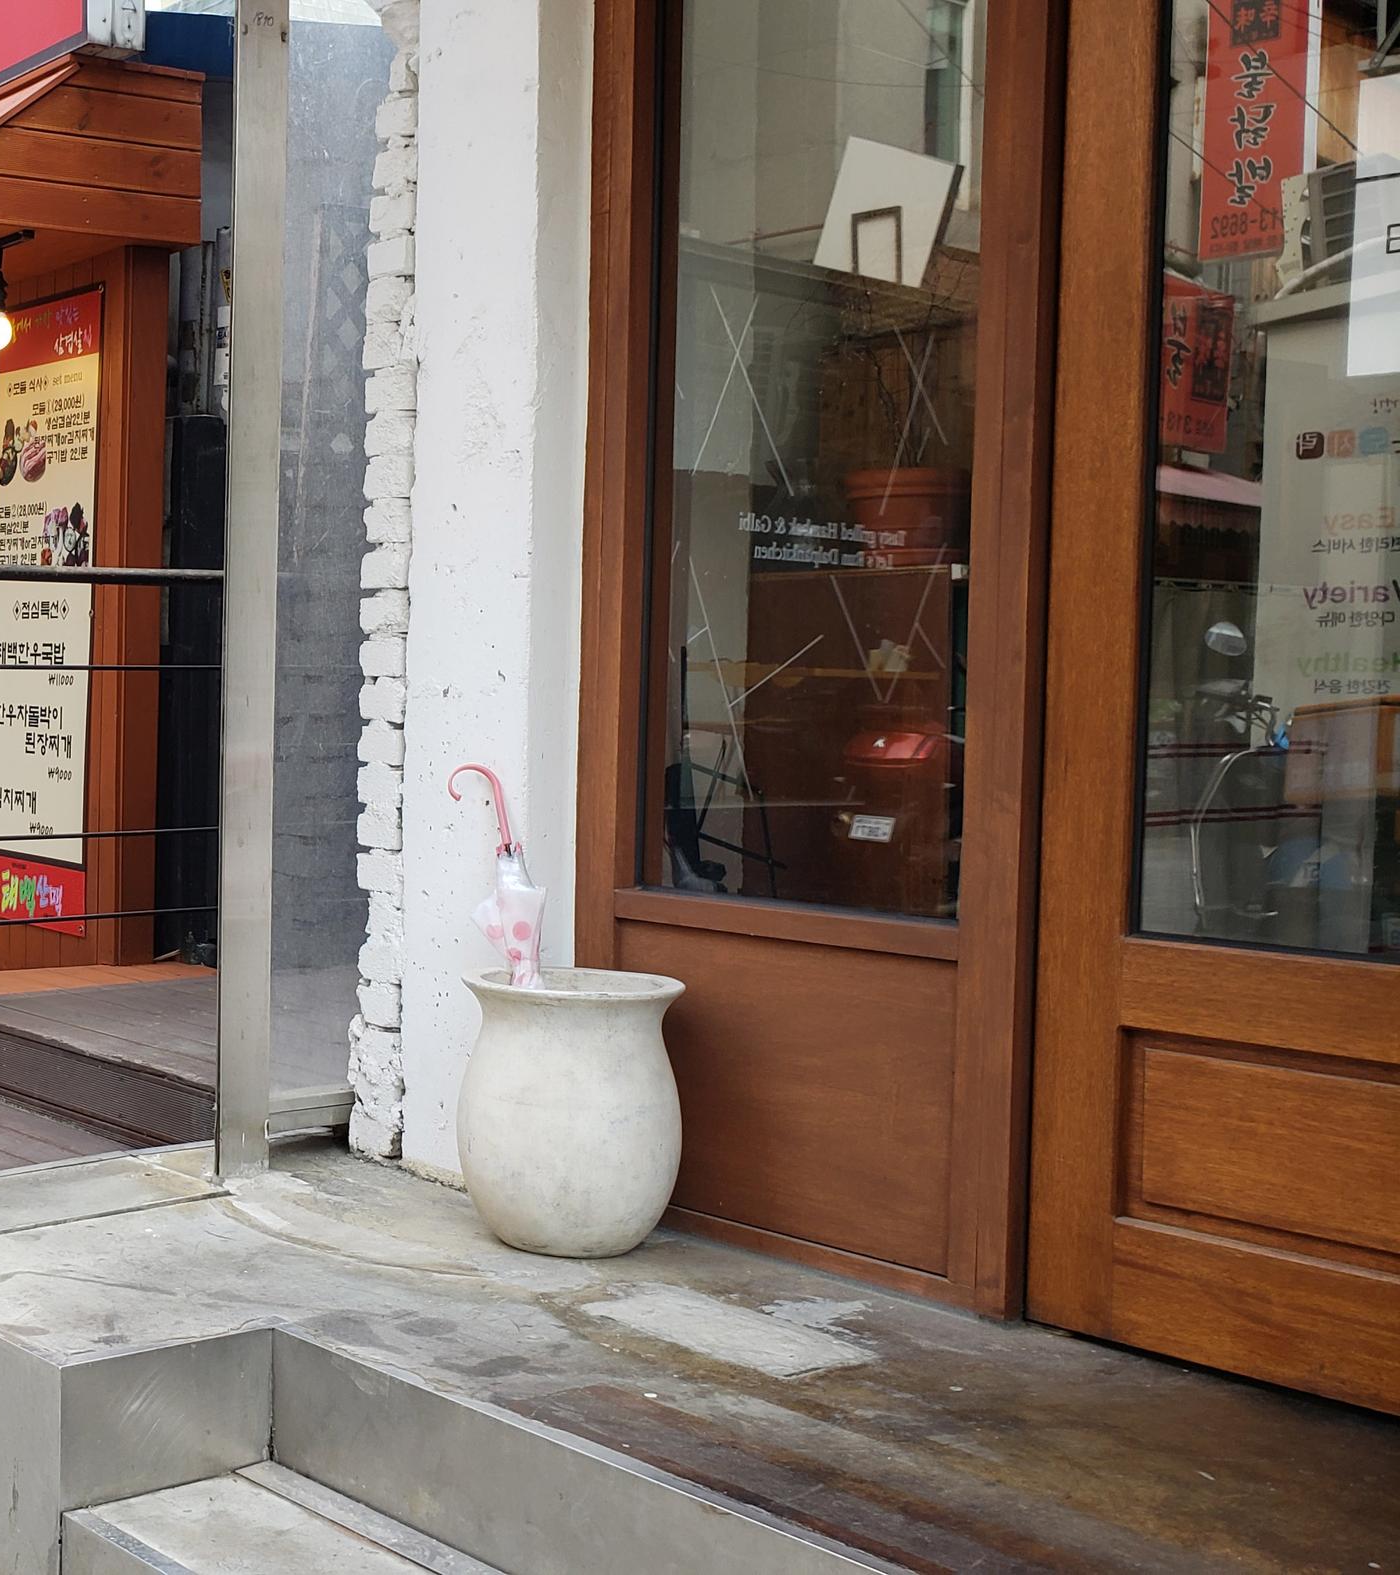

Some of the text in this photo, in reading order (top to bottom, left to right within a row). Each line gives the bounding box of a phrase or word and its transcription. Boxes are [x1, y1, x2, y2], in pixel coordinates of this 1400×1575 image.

[13, 380, 27, 396] 모듬
[21, 600, 59, 620] 점심특선
[25, 732, 73, 759] 된장찌개
[48, 766, 73, 783] ₩9000
